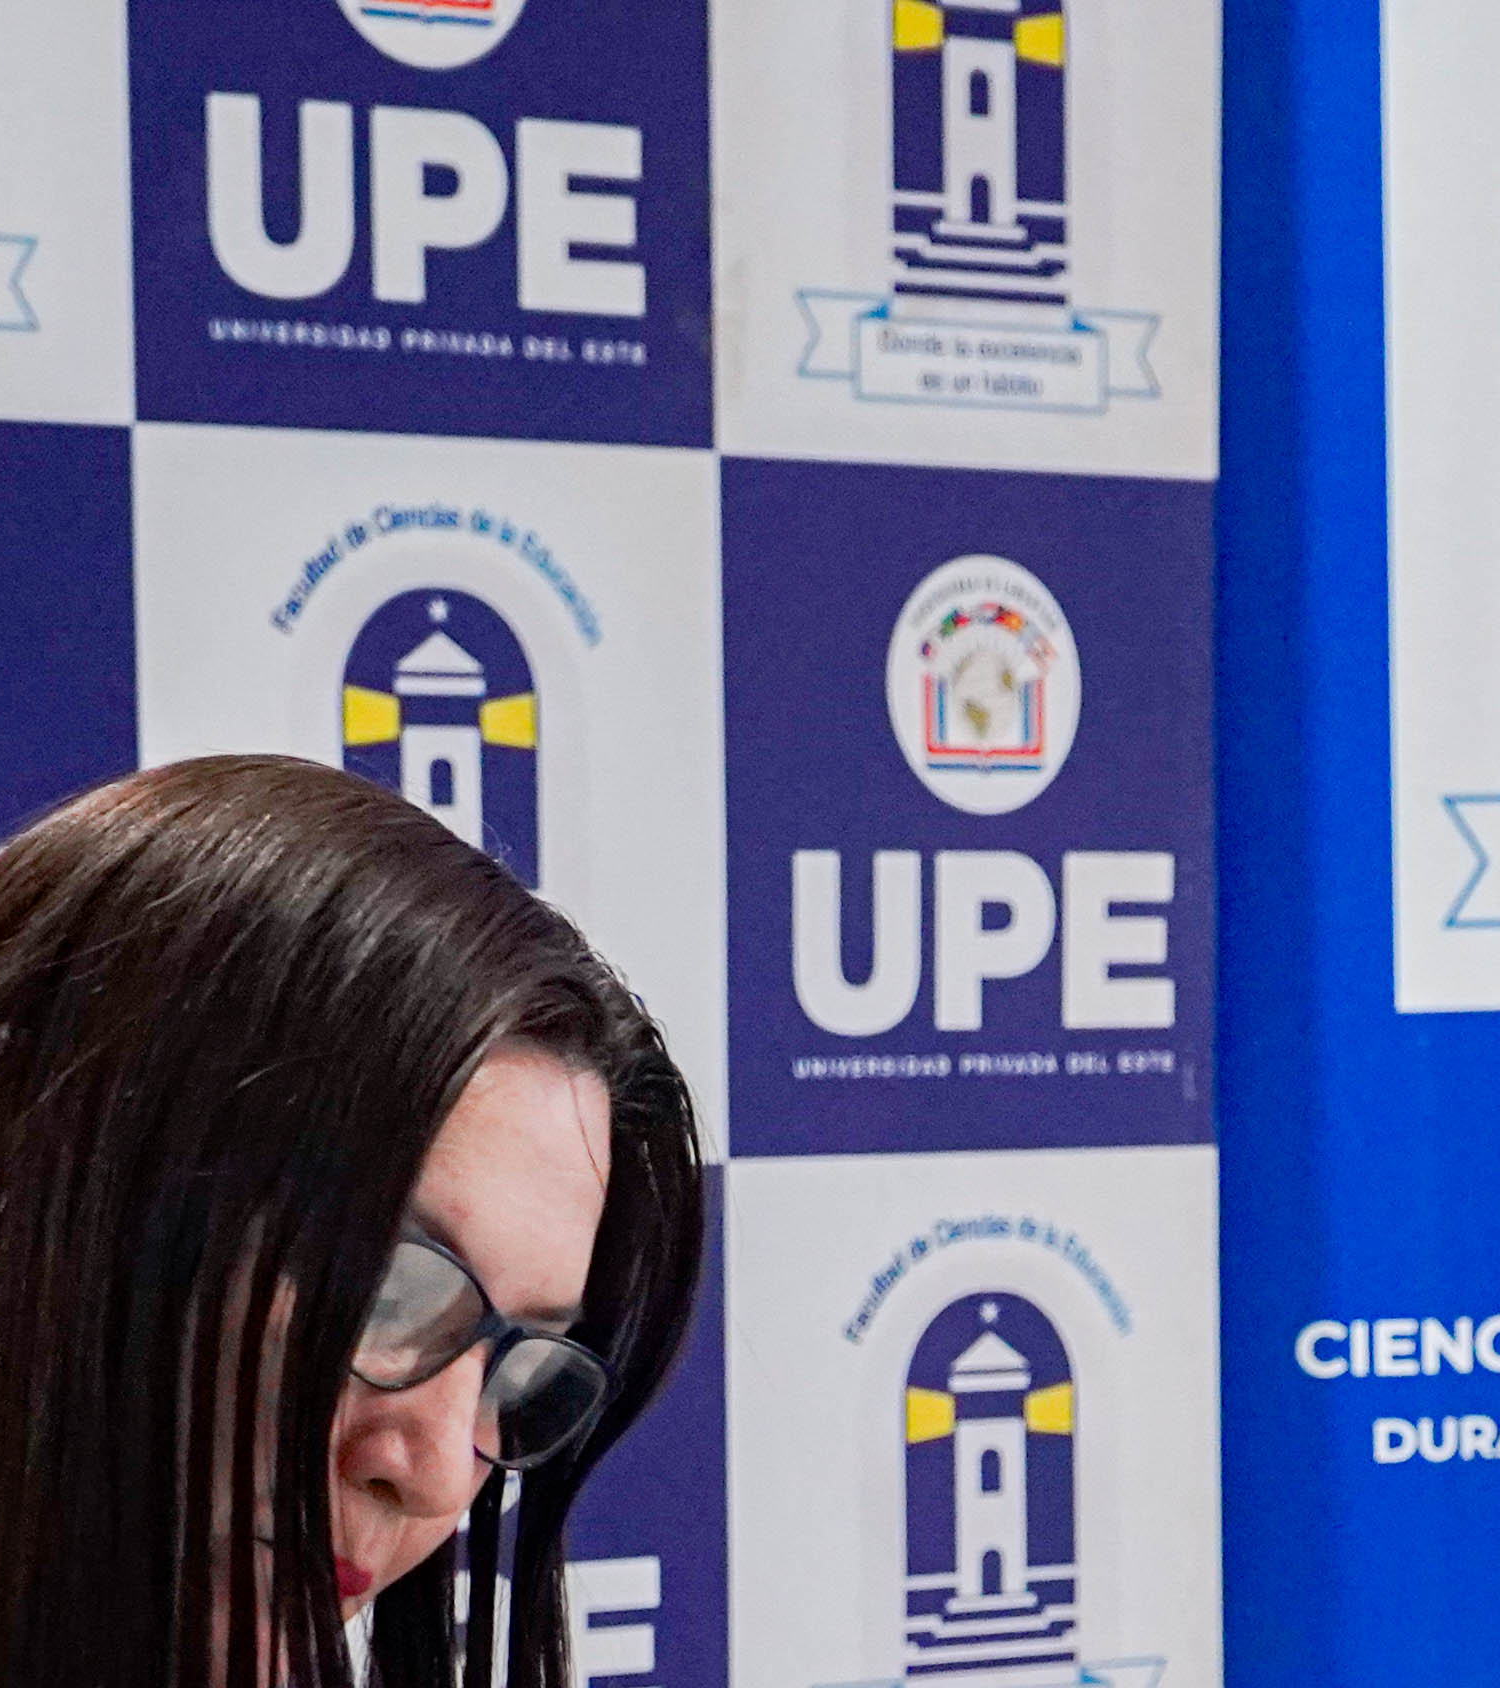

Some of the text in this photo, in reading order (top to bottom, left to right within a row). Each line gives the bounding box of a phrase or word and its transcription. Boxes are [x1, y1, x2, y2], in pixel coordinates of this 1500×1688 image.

[206, 92, 646, 316] UPE
[209, 318, 647, 367] UNIVERSIDAD PRIVADA DEL ESTE
[792, 849, 1175, 1036] UPE
